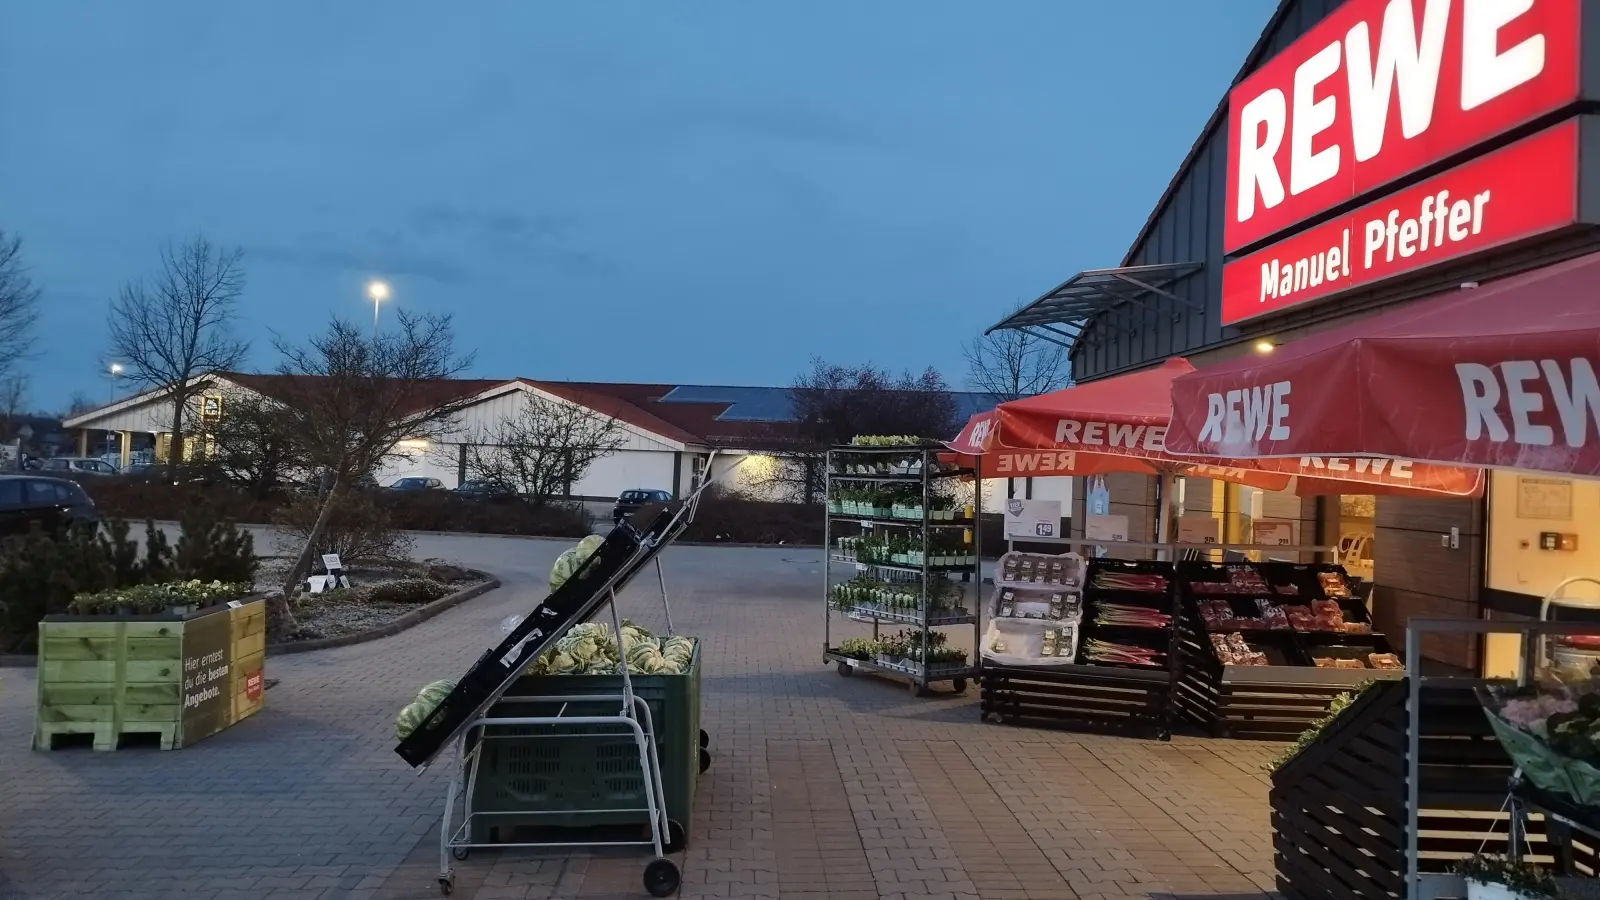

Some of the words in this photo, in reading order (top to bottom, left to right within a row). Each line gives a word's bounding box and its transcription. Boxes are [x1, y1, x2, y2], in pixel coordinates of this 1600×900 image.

[1237, 0, 1545, 223] REWE
[1260, 229, 1351, 302] Manuel
[1364, 189, 1491, 269] Pfeffer
[1198, 380, 1292, 443] REWE
[1454, 357, 1600, 448] REW
[968, 418, 991, 448] REW
[1055, 419, 1166, 451] REWE
[1037, 524, 1052, 536] 1.49
[185, 656, 199, 672] Hier
[201, 648, 224, 666] erntest
[185, 676, 194, 689] du
[196, 671, 206, 686] die
[208, 664, 229, 682] besten
[184, 685, 220, 708] Angebote.
